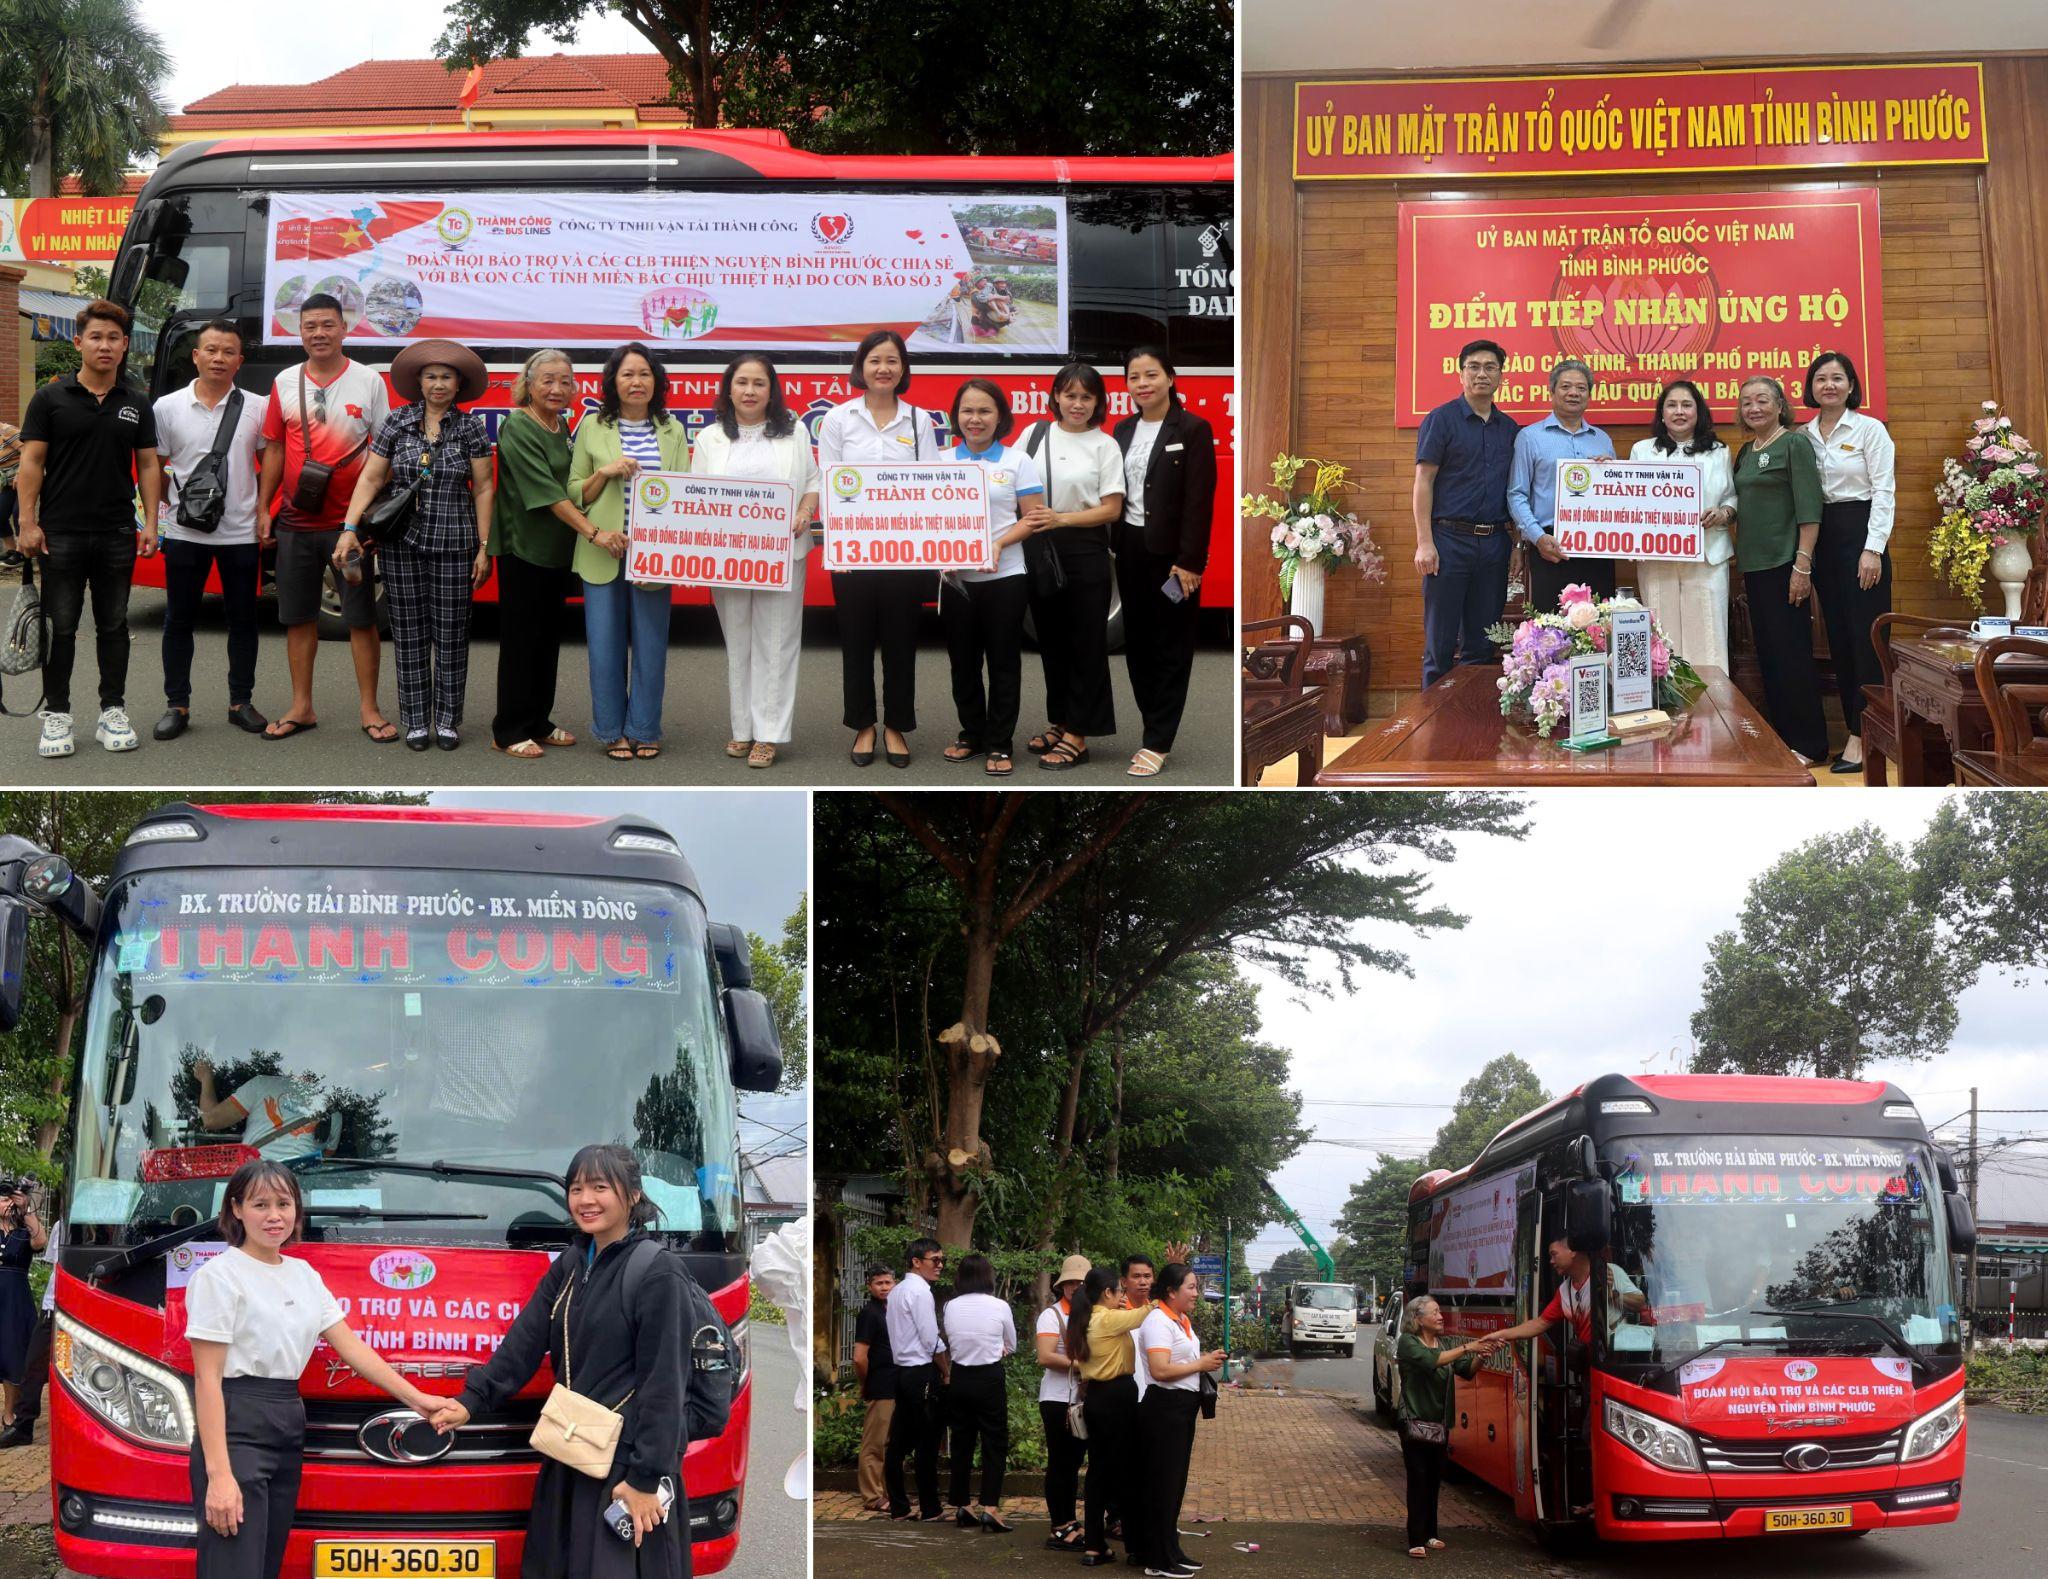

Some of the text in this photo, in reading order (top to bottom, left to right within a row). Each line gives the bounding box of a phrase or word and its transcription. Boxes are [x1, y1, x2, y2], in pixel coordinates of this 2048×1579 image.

[1342, 114, 1391, 156] BAN
[1397, 103, 1447, 163] MẶT
[1453, 102, 1519, 162] TRẬN
[1524, 87, 1555, 153] TỔ
[1560, 93, 1623, 156] QUỐC
[1630, 97, 1681, 156] VIỆT
[1687, 104, 1746, 149] NAM
[1750, 87, 1810, 147] TỈNH
[1817, 91, 1878, 145] BÌNH
[1884, 88, 1971, 142] PHƯỚC
[61, 207, 103, 228] NHIỆT
[476, 214, 552, 226] THÀNH CÔNG
[559, 218, 798, 233] CÔNG TY TNHH VẬN TẢI THÀNH CÔNG
[505, 227, 551, 235] BUS LINES
[1503, 230, 1537, 247] BAN
[1542, 225, 1577, 250] MẶT
[1582, 224, 1625, 249] TRẬN
[1630, 217, 1652, 245] TỔ
[1657, 218, 1709, 243] QUỐC
[1715, 219, 1748, 246] VIỆT
[1754, 223, 1794, 241] NAM
[32, 232, 46, 251] VÌ
[50, 235, 81, 255] NẠN
[407, 251, 953, 271] ĐOÀN HỘI BẢO TRỢ VÀ CÁC CLB THIỆN NGUYỆN BÌNH PHƯỚC CHIA SẺ
[1559, 252, 1709, 277] TỈNH BÌNH PHƯỚC
[418, 269, 942, 288] VỚI BÀ CON CÁC TỈNH MIỀN BẮC CHỊU THIỆT HẠI DO CƠN BÃO SỐ 3
[1429, 288, 1849, 330] ĐIỂM TIẾP NHẬN ỦNG HỘ
[1636, 350, 1698, 371] THÀNH
[1703, 346, 1742, 369] PHỐ
[1747, 348, 1793, 369] PHÍA
[877, 470, 966, 483] CÔNG TY TNHH VẬN TẢI
[1604, 469, 1684, 481] CÔNG TY TNHH VẬN TẢI
[685, 483, 775, 500] CÔNG TY TNHH VẬN TẢI
[865, 484, 979, 501] THÀNH CÔNG
[1592, 481, 1695, 498] THÀNH CÔNG
[671, 499, 786, 521] THÀNH CÔNG
[832, 539, 983, 563] 13.000.000đ
[1560, 531, 1696, 555] 40.000.000đ
[633, 552, 785, 584] 40.000.000đ
[179, 885, 637, 921] BX. TRƯỜNG HẢI BÌNH PHƯỚC BX. MIỀN ĐÔNG
[1654, 1146, 1901, 1168] BX. TRƯỜNG HẢI BÌNH PHƯỚC BX. MIỀN ĐÔNG
[358, 1297, 402, 1320] TRỢ
[409, 1296, 437, 1317] VÀ
[445, 1297, 490, 1319] CÁC
[412, 1327, 468, 1350] BÌNH
[1693, 1383, 1903, 1398] ĐOÀN HỘI BẢO TRỢ VÀ CÁC CLB THIỆN
[1728, 1400, 1876, 1415] NGUYỆN TỈNH BÌNH PHƯỚC
[1772, 1511, 1845, 1527] 50H-360.30
[331, 1549, 479, 1572] 50H-360.30
